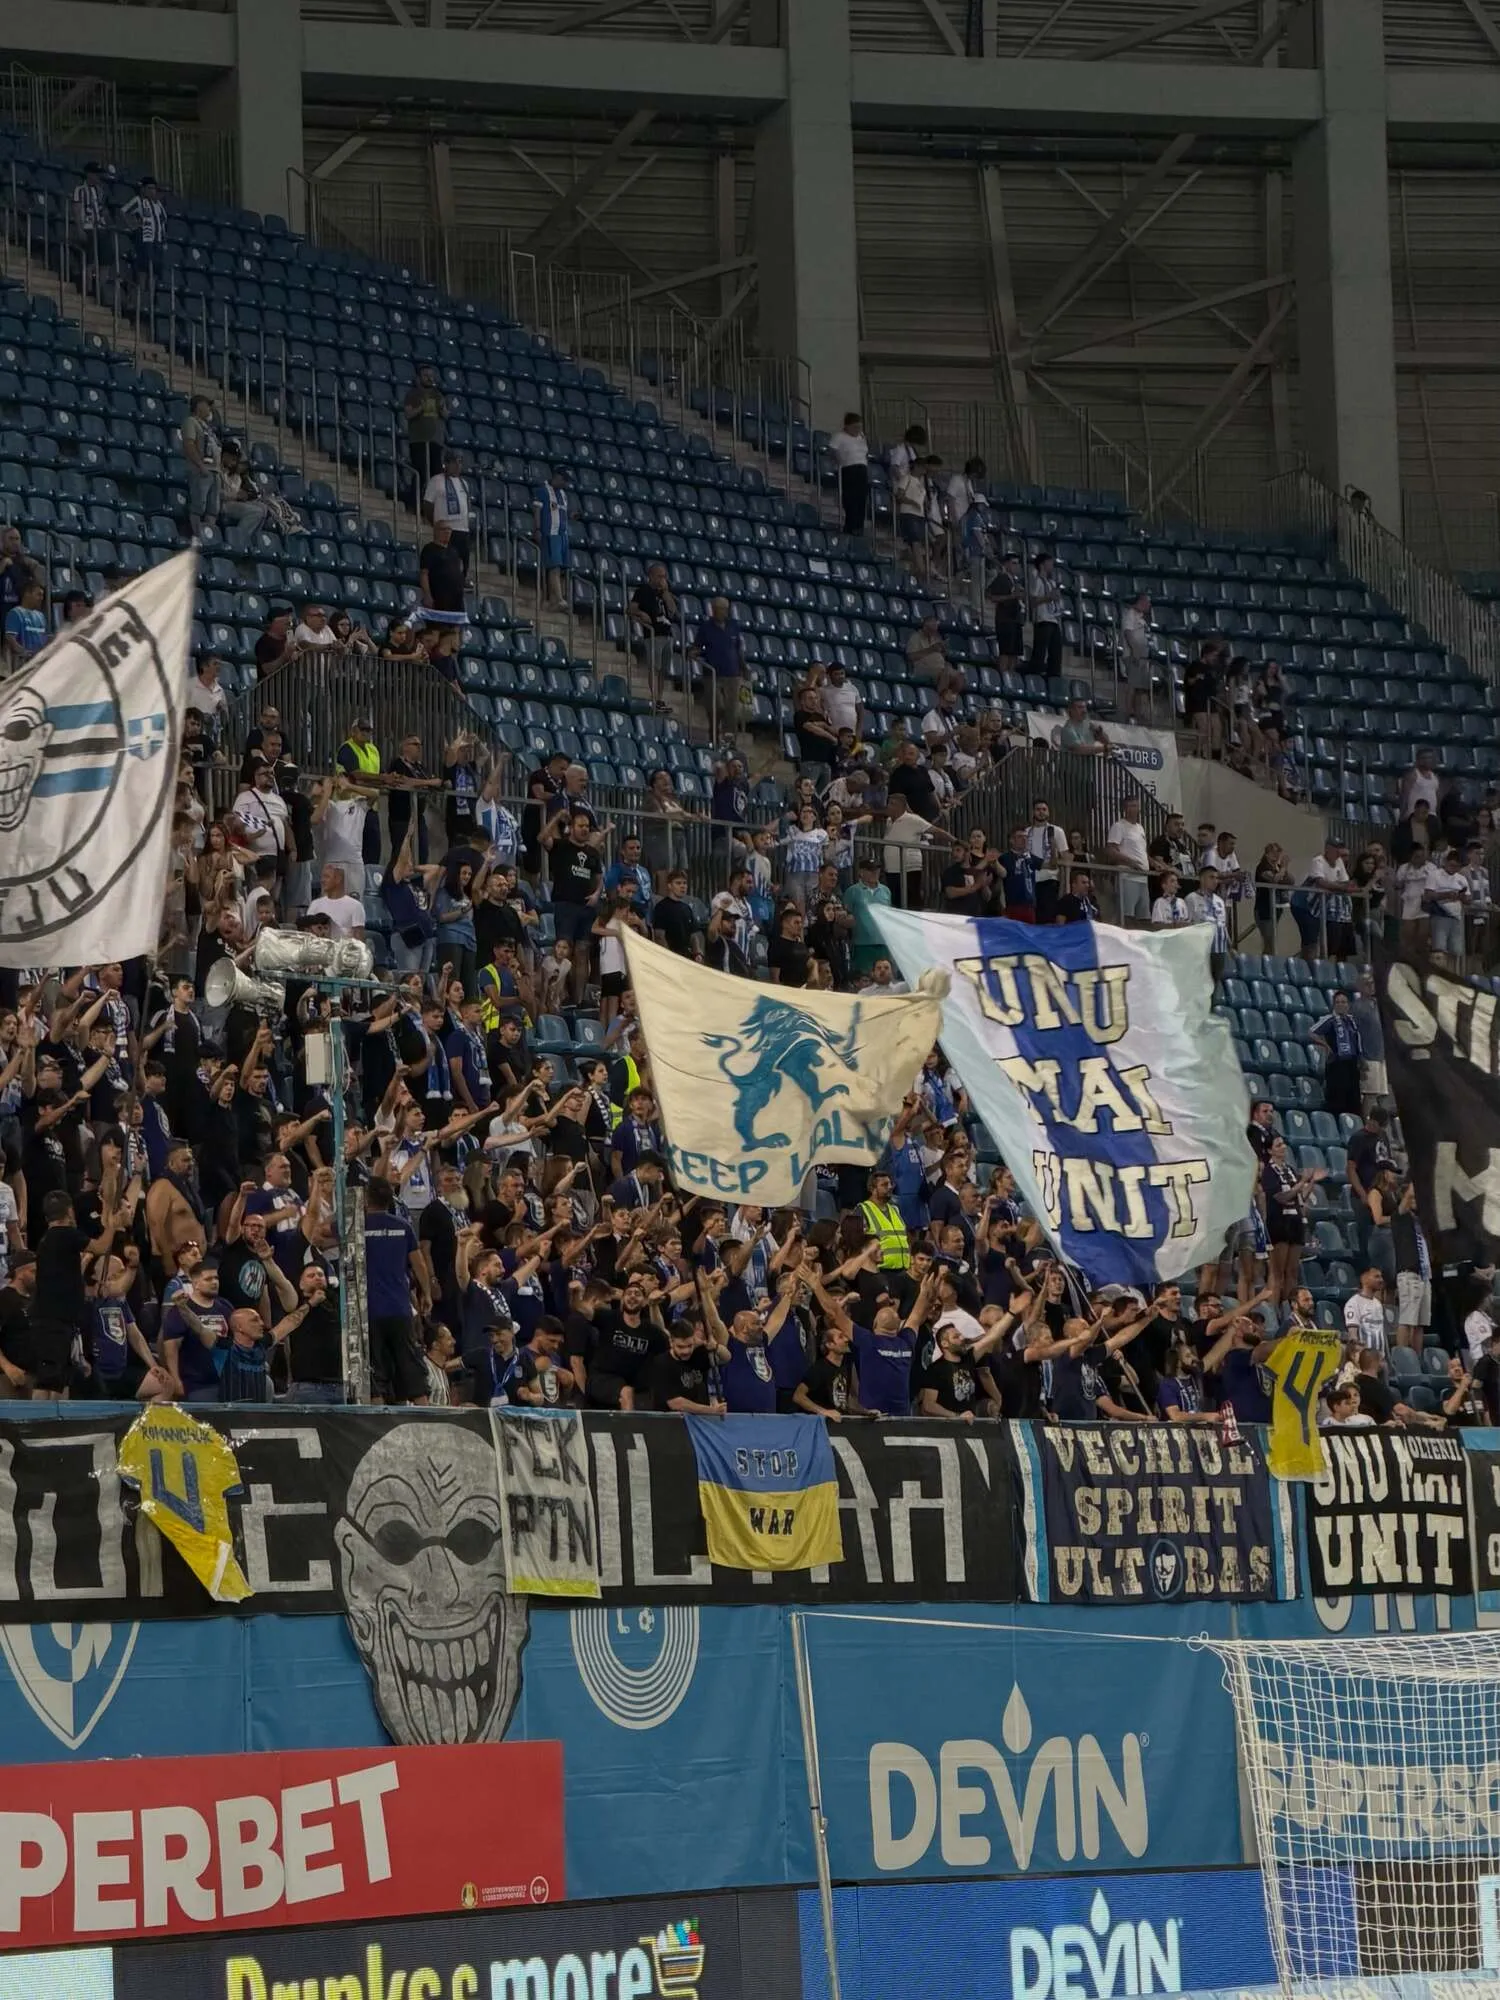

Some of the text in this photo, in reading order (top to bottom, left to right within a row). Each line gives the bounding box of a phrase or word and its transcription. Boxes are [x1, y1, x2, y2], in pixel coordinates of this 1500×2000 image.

[954, 953, 1130, 1044] UNU
[997, 1056, 1173, 1136] MAI
[669, 1145, 769, 1195] KEEP
[1033, 1149, 1210, 1238] UNIT
[498, 1416, 587, 1485] FCK
[735, 1447, 800, 1479] STOP
[1043, 1425, 1256, 1477] VECHIUL
[506, 1494, 593, 1566] PTN
[749, 1506, 795, 1537] WAR
[1074, 1485, 1243, 1538] SPIRIT
[1314, 1512, 1465, 1586] UNIT
[868, 1732, 1149, 1871] DEVIN
[0, 1761, 400, 1932] PERBET
[1010, 1918, 1181, 2000] DEVIN
